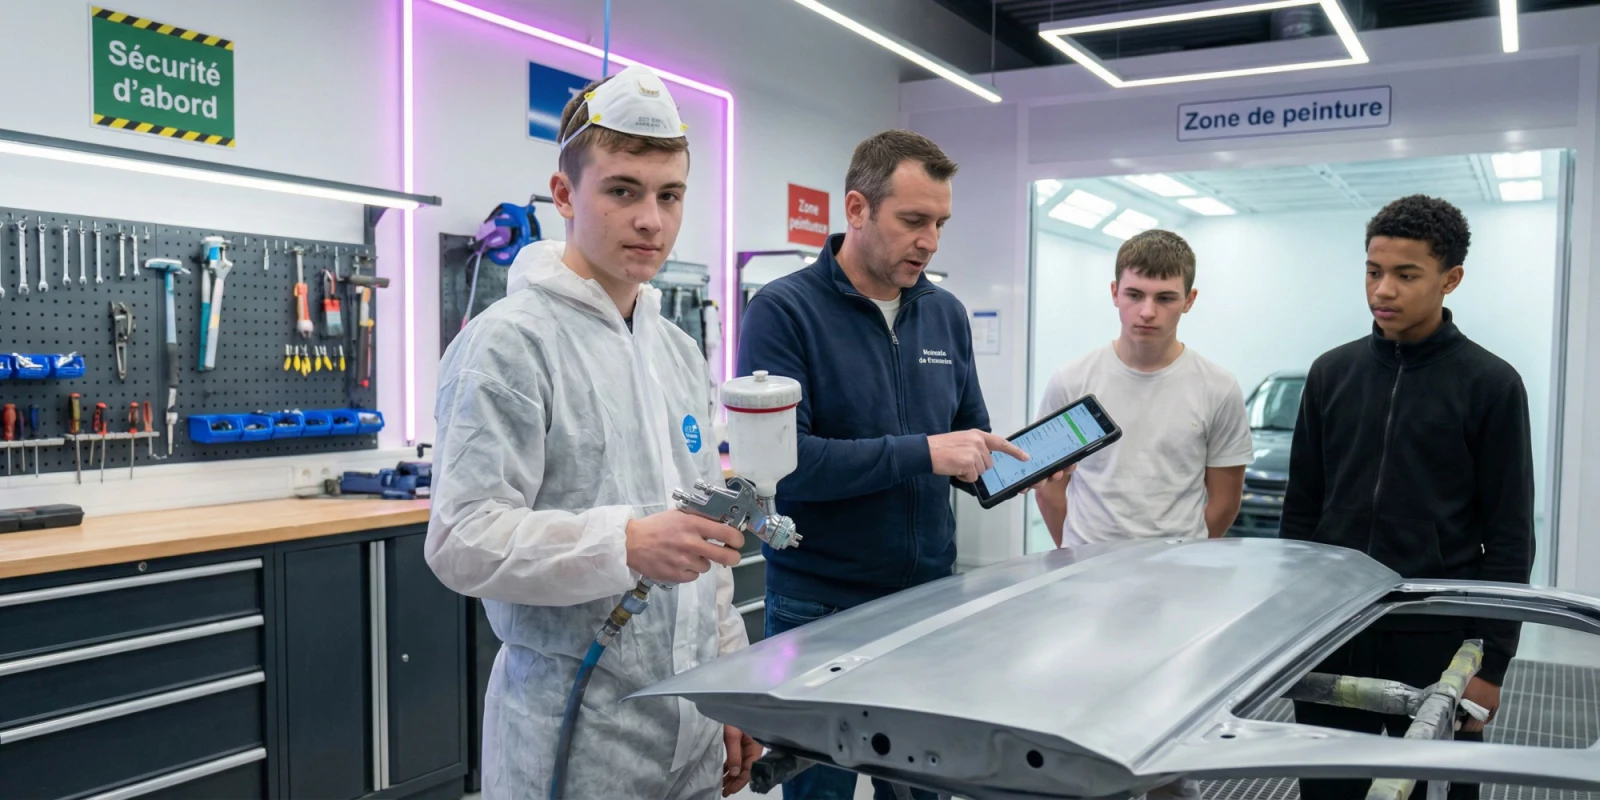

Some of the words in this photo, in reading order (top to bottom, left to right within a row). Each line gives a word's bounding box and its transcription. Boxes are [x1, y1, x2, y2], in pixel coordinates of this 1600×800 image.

[108, 40, 221, 87] Sécurité
[1184, 111, 1240, 131] Zone
[1247, 106, 1275, 126] de
[1283, 100, 1383, 128] peinture
[798, 199, 819, 217] Zone
